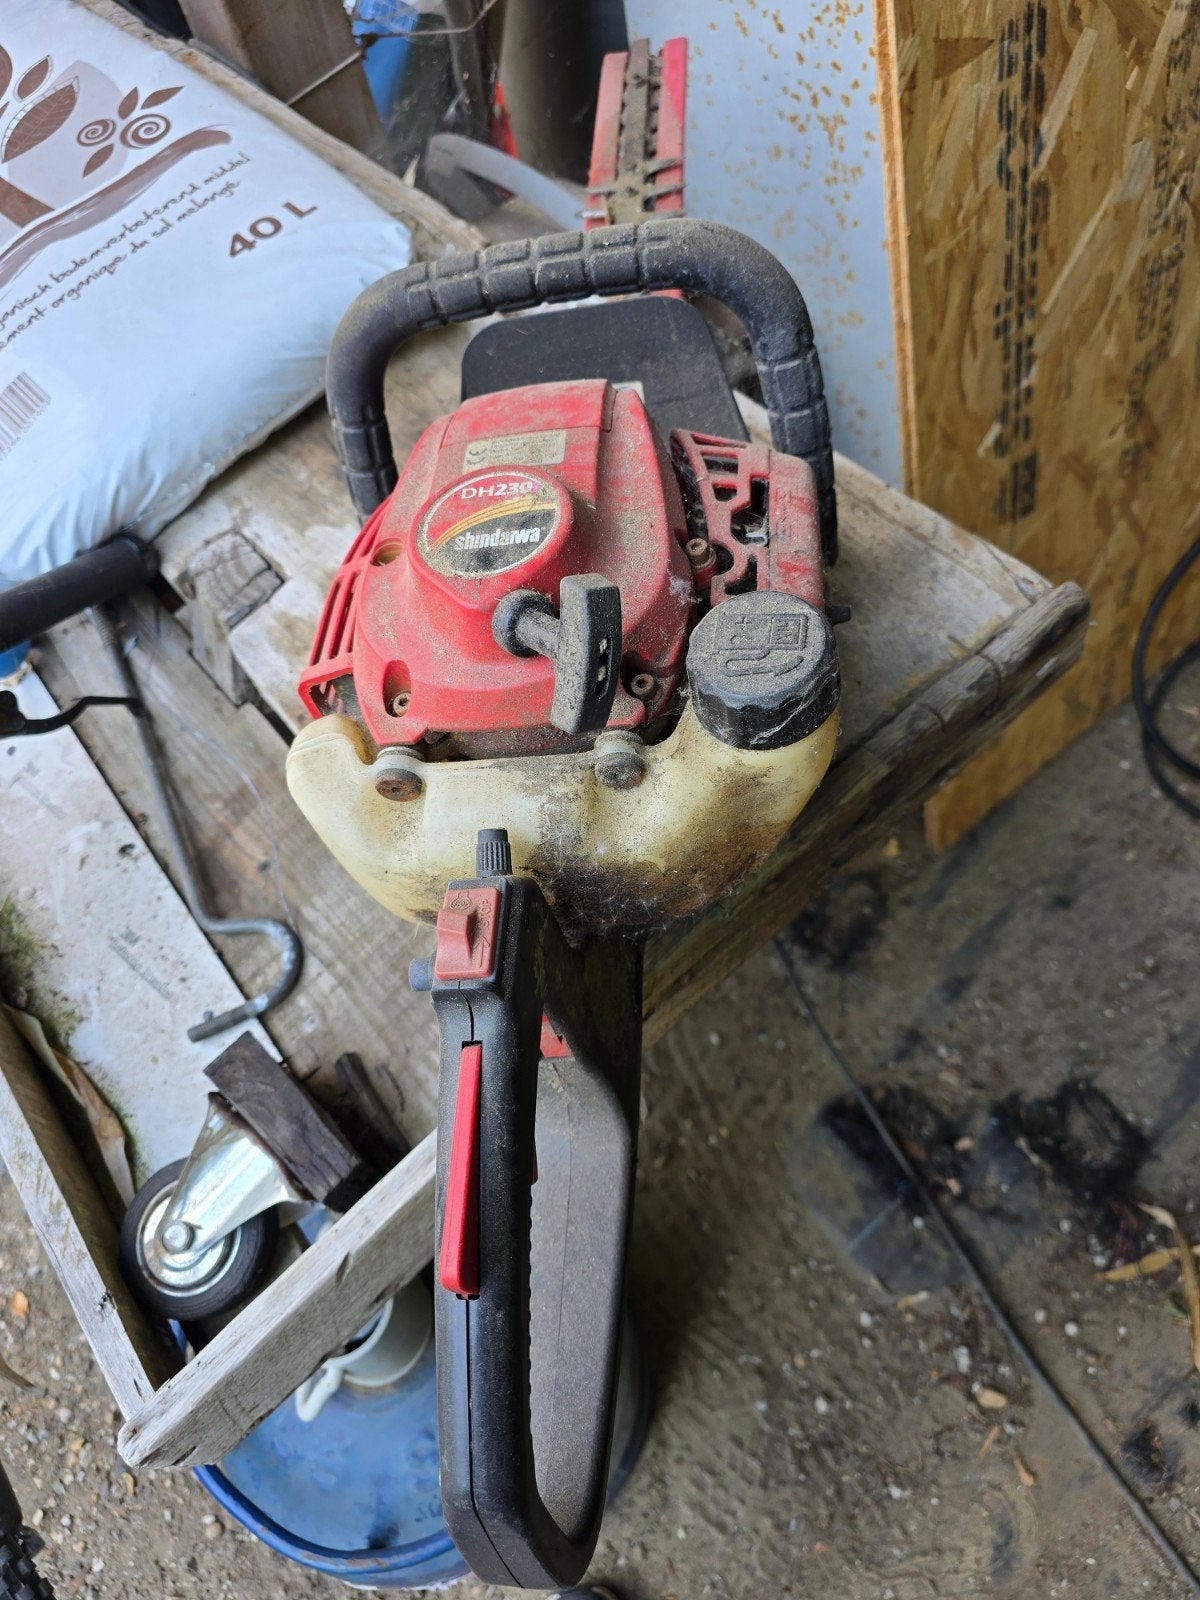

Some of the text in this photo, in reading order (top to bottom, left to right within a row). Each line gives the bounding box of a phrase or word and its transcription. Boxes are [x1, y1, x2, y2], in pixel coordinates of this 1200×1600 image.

[228, 199, 318, 259] 40 L
[51, 253, 128, 308] organique
[151, 217, 175, 238] sol
[460, 480, 534, 500] DH230
[453, 525, 541, 550] shindaiwa
[480, 898, 492, 928] STOP
